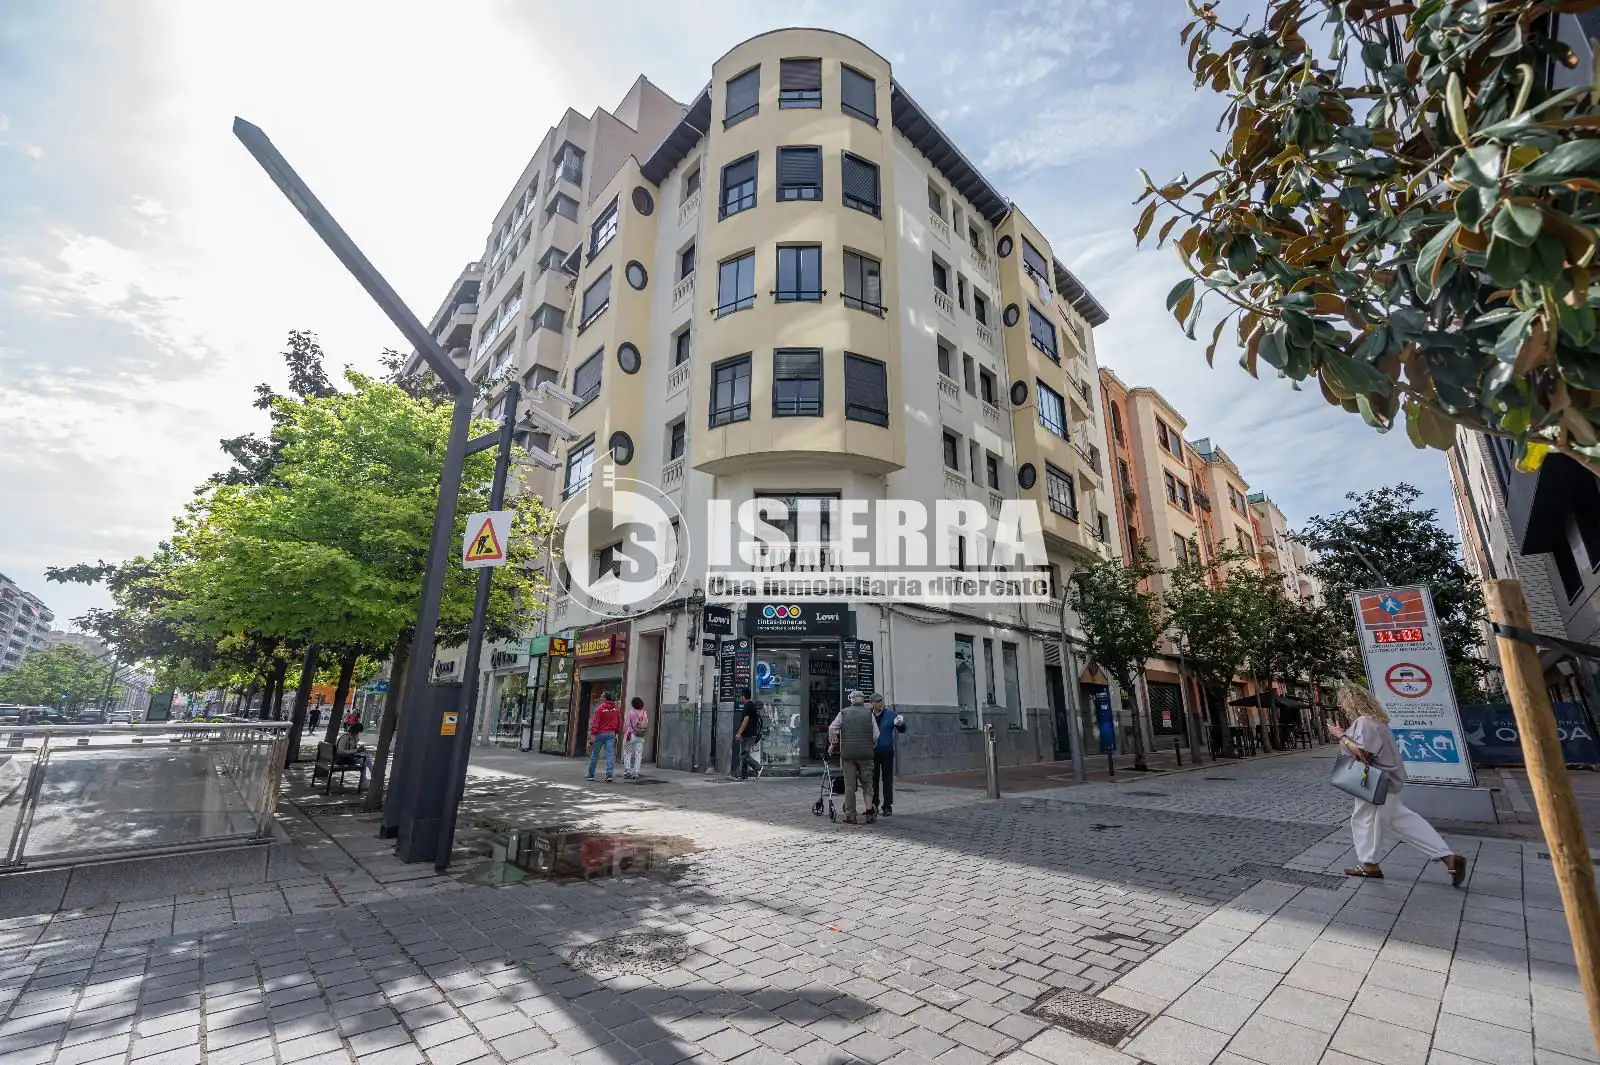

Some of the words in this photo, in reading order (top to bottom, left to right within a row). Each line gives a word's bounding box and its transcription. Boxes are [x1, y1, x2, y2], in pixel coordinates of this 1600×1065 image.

[708, 613, 730, 625] Lowi
[815, 612, 839, 621] Lowi
[582, 638, 610, 654] TABACOS
